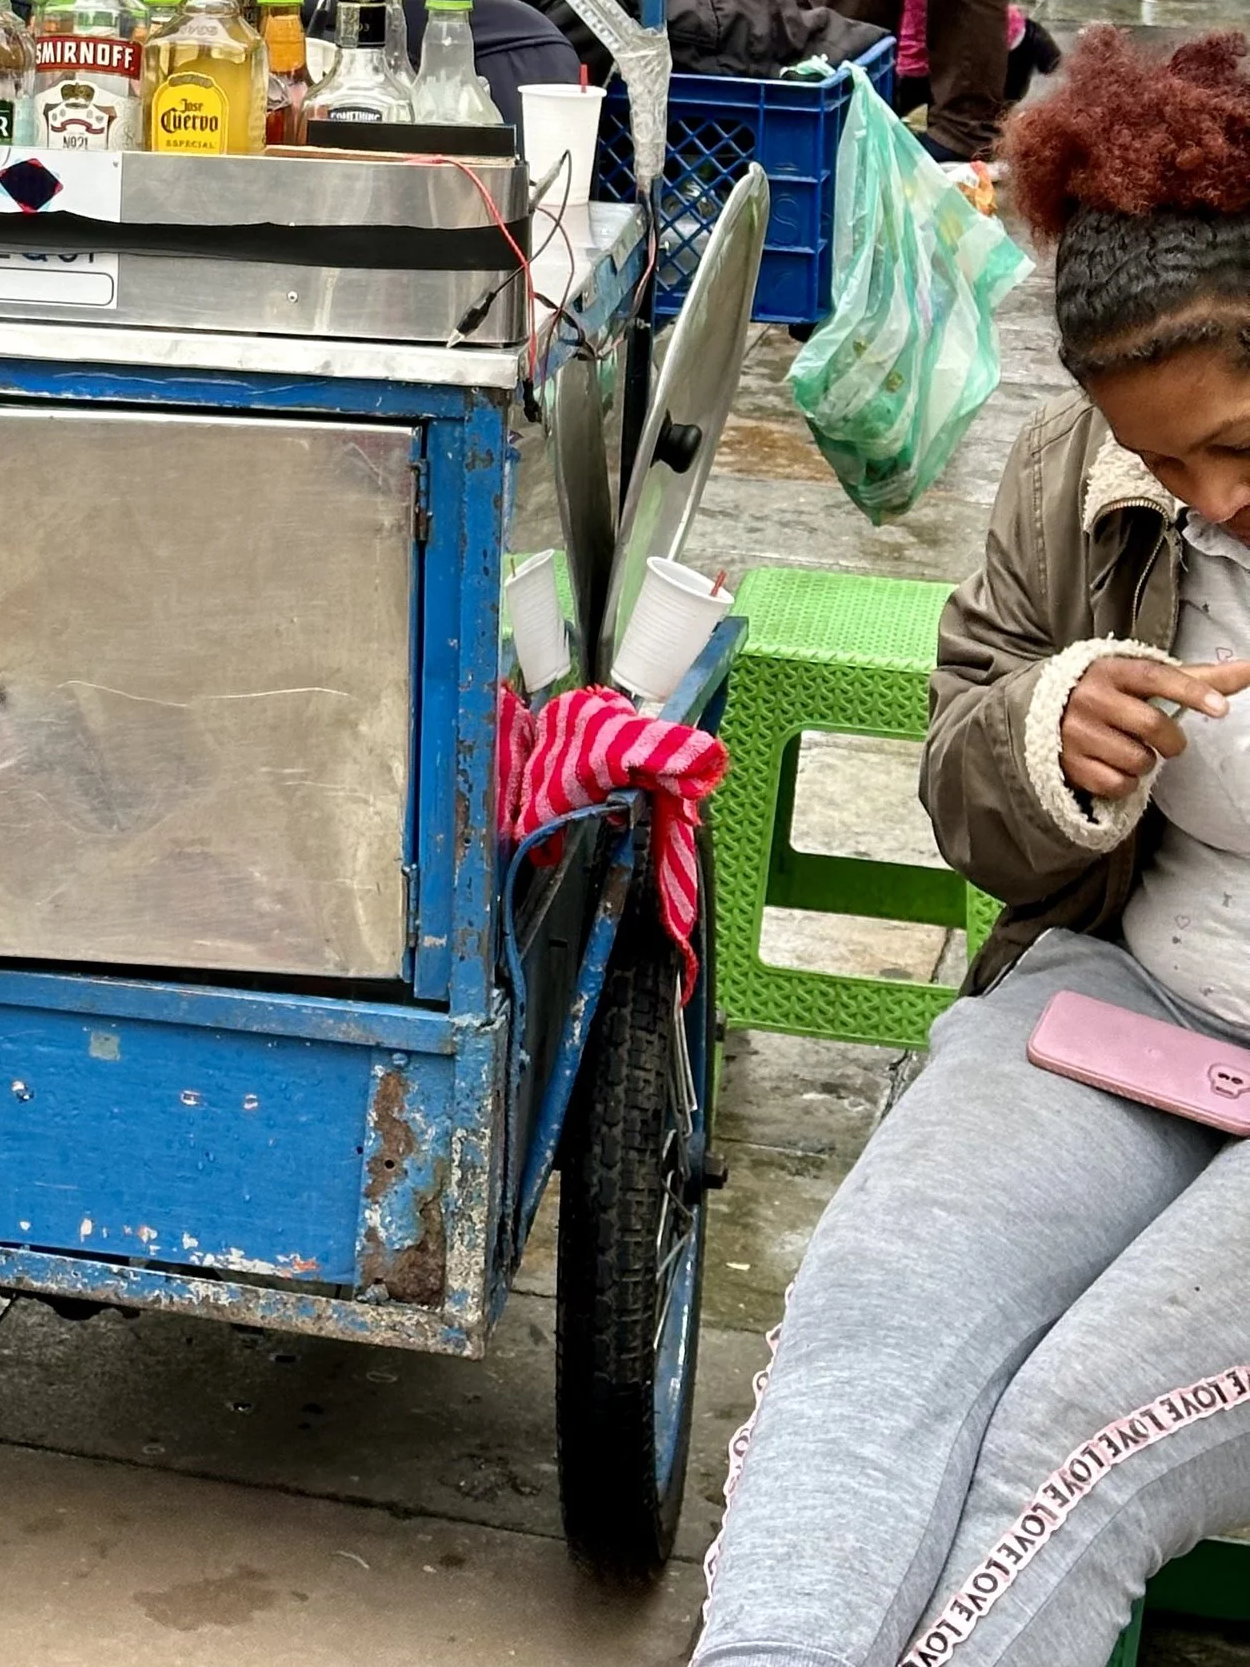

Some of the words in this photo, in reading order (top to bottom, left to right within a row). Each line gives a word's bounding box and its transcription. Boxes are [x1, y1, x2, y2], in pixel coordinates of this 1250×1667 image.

[36, 40, 135, 69] SMIRNOFF
[161, 107, 219, 134] Cuervo
[180, 98, 204, 113] Jose
[166, 139, 215, 149] ESPECIAL
[1159, 1380, 1227, 1424] LOVE
[1097, 1410, 1165, 1458] LOVE
[1042, 1445, 1105, 1507] LOVE
[996, 1502, 1059, 1565] LOVE
[949, 1556, 1011, 1622] LOVE
[898, 1618, 963, 1667] LOV
